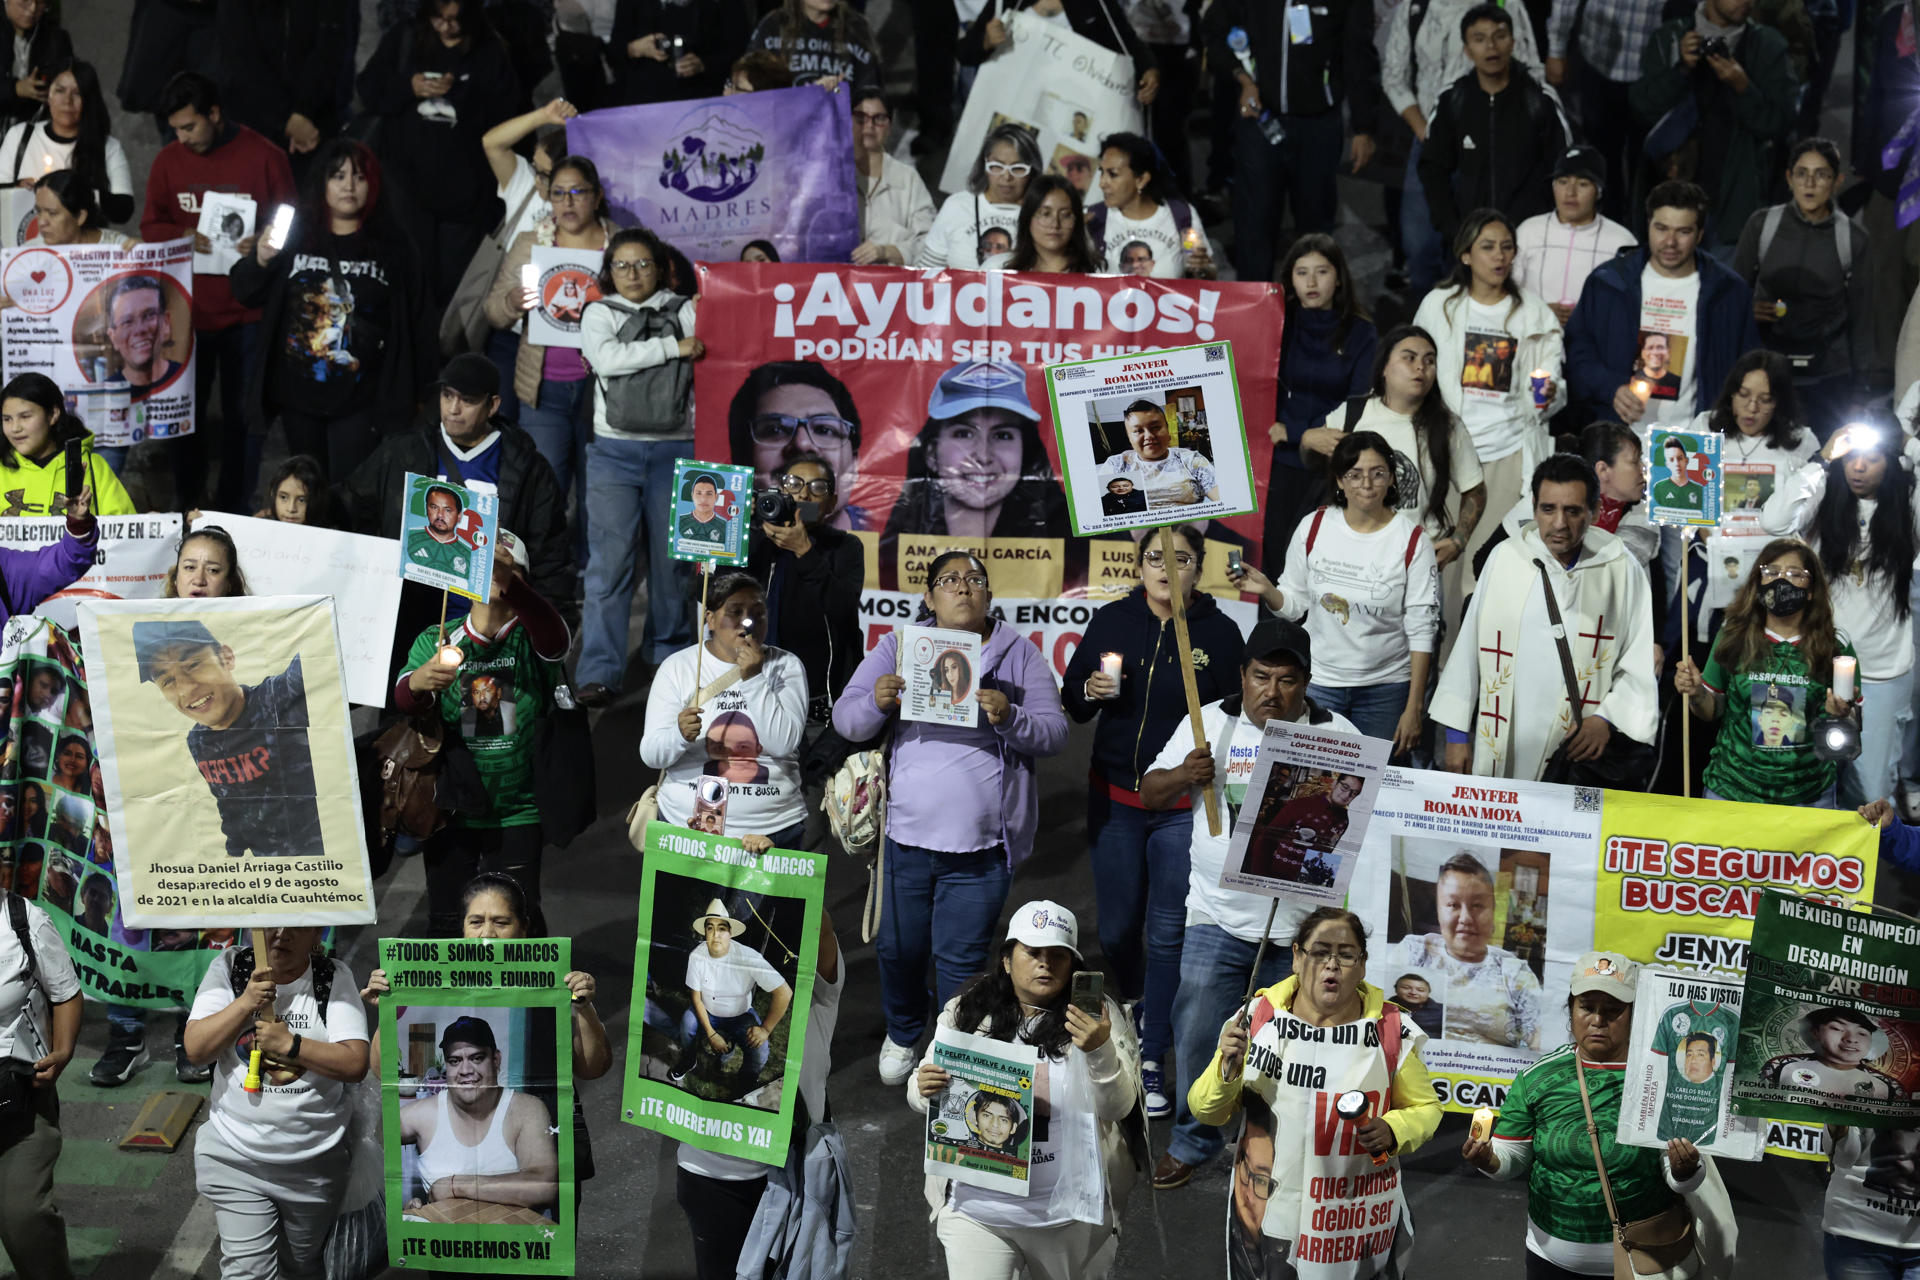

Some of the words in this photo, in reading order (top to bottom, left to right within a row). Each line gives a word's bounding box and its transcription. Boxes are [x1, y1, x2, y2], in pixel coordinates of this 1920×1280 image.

[661, 198, 771, 224] MADRES
[773, 268, 1221, 341] ¡Ayúdanos!
[794, 332, 945, 362] PODRÍAN
[952, 340, 1013, 363] SER
[1020, 341, 1082, 365] TUS
[1122, 359, 1168, 373] JENYFER
[1104, 374, 1140, 386] ROMAN
[1143, 369, 1174, 380] MOYA
[0, 523, 65, 542] COLECTIVO
[101, 523, 124, 540] LUZ
[128, 522, 144, 540] EN
[148, 522, 164, 539] EL
[905, 545, 937, 557] ANA
[992, 546, 1052, 560] GARCÍA
[1102, 551, 1134, 563] LUIS
[1101, 566, 1142, 580] AYAL
[1749, 671, 1810, 685] DESAPARECIDO
[1293, 733, 1340, 746] GUILLERMO
[1230, 745, 1253, 758] Hasta
[1317, 746, 1360, 759] ESCOBEDO
[1226, 758, 1255, 777] Jenyfer
[743, 786, 752, 796] TE
[755, 786, 781, 797] BUSCA
[1452, 785, 1519, 805] JENYFER
[1396, 811, 1404, 819] 13
[1405, 811, 1435, 823] DICIEMBRE
[1462, 820, 1483, 830] BARRIO
[1485, 822, 1496, 831] SAN
[1424, 800, 1479, 818] ROMAN
[1480, 806, 1523, 824] MOYA
[1404, 820, 1411, 828] 21
[1412, 820, 1427, 830] AÑOS
[1428, 823, 1435, 831] DE
[1437, 824, 1452, 833] EDAD
[1453, 826, 1460, 834] AL
[1461, 827, 1488, 838] MOMENTO
[1491, 831, 1498, 839] DE
[1499, 832, 1540, 844] DESAPARECER
[149, 863, 194, 874] Jhosua
[199, 862, 240, 874] Daniel
[243, 861, 292, 875] Arriaga
[295, 860, 343, 872] Castillo
[1607, 839, 1666, 873] ¡TE
[1673, 845, 1861, 890] SEGUIMOS
[157, 879, 246, 892] desaparecido
[249, 878, 260, 889] el
[263, 878, 272, 888] 9
[275, 877, 291, 888] de
[294, 878, 339, 890] agosto
[137, 894, 154, 905] de
[156, 895, 188, 906] 2021
[192, 897, 210, 906] en
[213, 895, 224, 906] la
[227, 893, 278, 905] alcaldía
[281, 891, 364, 904] Cuauhtémoc
[1779, 899, 1843, 928] MÉXICO
[71, 928, 138, 973] HASTA
[386, 943, 559, 965] #TODOS_SOMOS_MARCOS
[1659, 935, 1750, 966] JENYF
[1841, 934, 1864, 956] EN
[1787, 944, 1909, 986] DESAPARICIÓN
[394, 970, 556, 990] #TODOS_SOMOS_EDUARDO
[1751, 955, 1920, 1007] DESAPARECID
[1669, 982, 1685, 998] !LO
[1687, 984, 1708, 1001] HAS
[1774, 985, 1813, 1002] Brayan
[1816, 994, 1852, 1008] Torres
[1854, 1001, 1901, 1019] Morales
[1332, 1026, 1358, 1045] un
[935, 1046, 943, 1055] LA
[944, 1050, 971, 1061] PELOTA
[973, 1056, 999, 1069] VUELVE
[1432, 1050, 1452, 1058] sabes
[1454, 1050, 1475, 1060] dónde
[944, 1059, 971, 1070] nuestros
[973, 1065, 1016, 1082] desaparecidos
[1246, 1043, 1283, 1080] exige
[1287, 1062, 1327, 1089] una
[1000, 1081, 1018, 1092] casa?
[1666, 1092, 1683, 1100] ROJAS
[1675, 1086, 1697, 1095] CARLOS
[1738, 1080, 1767, 1090] FECHA
[1780, 1084, 1841, 1101] DESAPARICIÓN
[1737, 1091, 1787, 1102] UBICACIÓN:
[1876, 1107, 1915, 1118] MÉXICO
[640, 1097, 664, 1118] ¡TE
[666, 1103, 744, 1142] QUEREMOS
[747, 1125, 772, 1148] YA!
[1310, 1174, 1348, 1200] que
[1353, 1167, 1398, 1197] nunca
[1312, 1200, 1366, 1231] debió
[1370, 1199, 1394, 1225] ser
[402, 1238, 427, 1256] ¡TE
[430, 1239, 521, 1260] QUEREMOS
[524, 1241, 551, 1260] YA!
[1297, 1226, 1396, 1264] ARREBATADA
